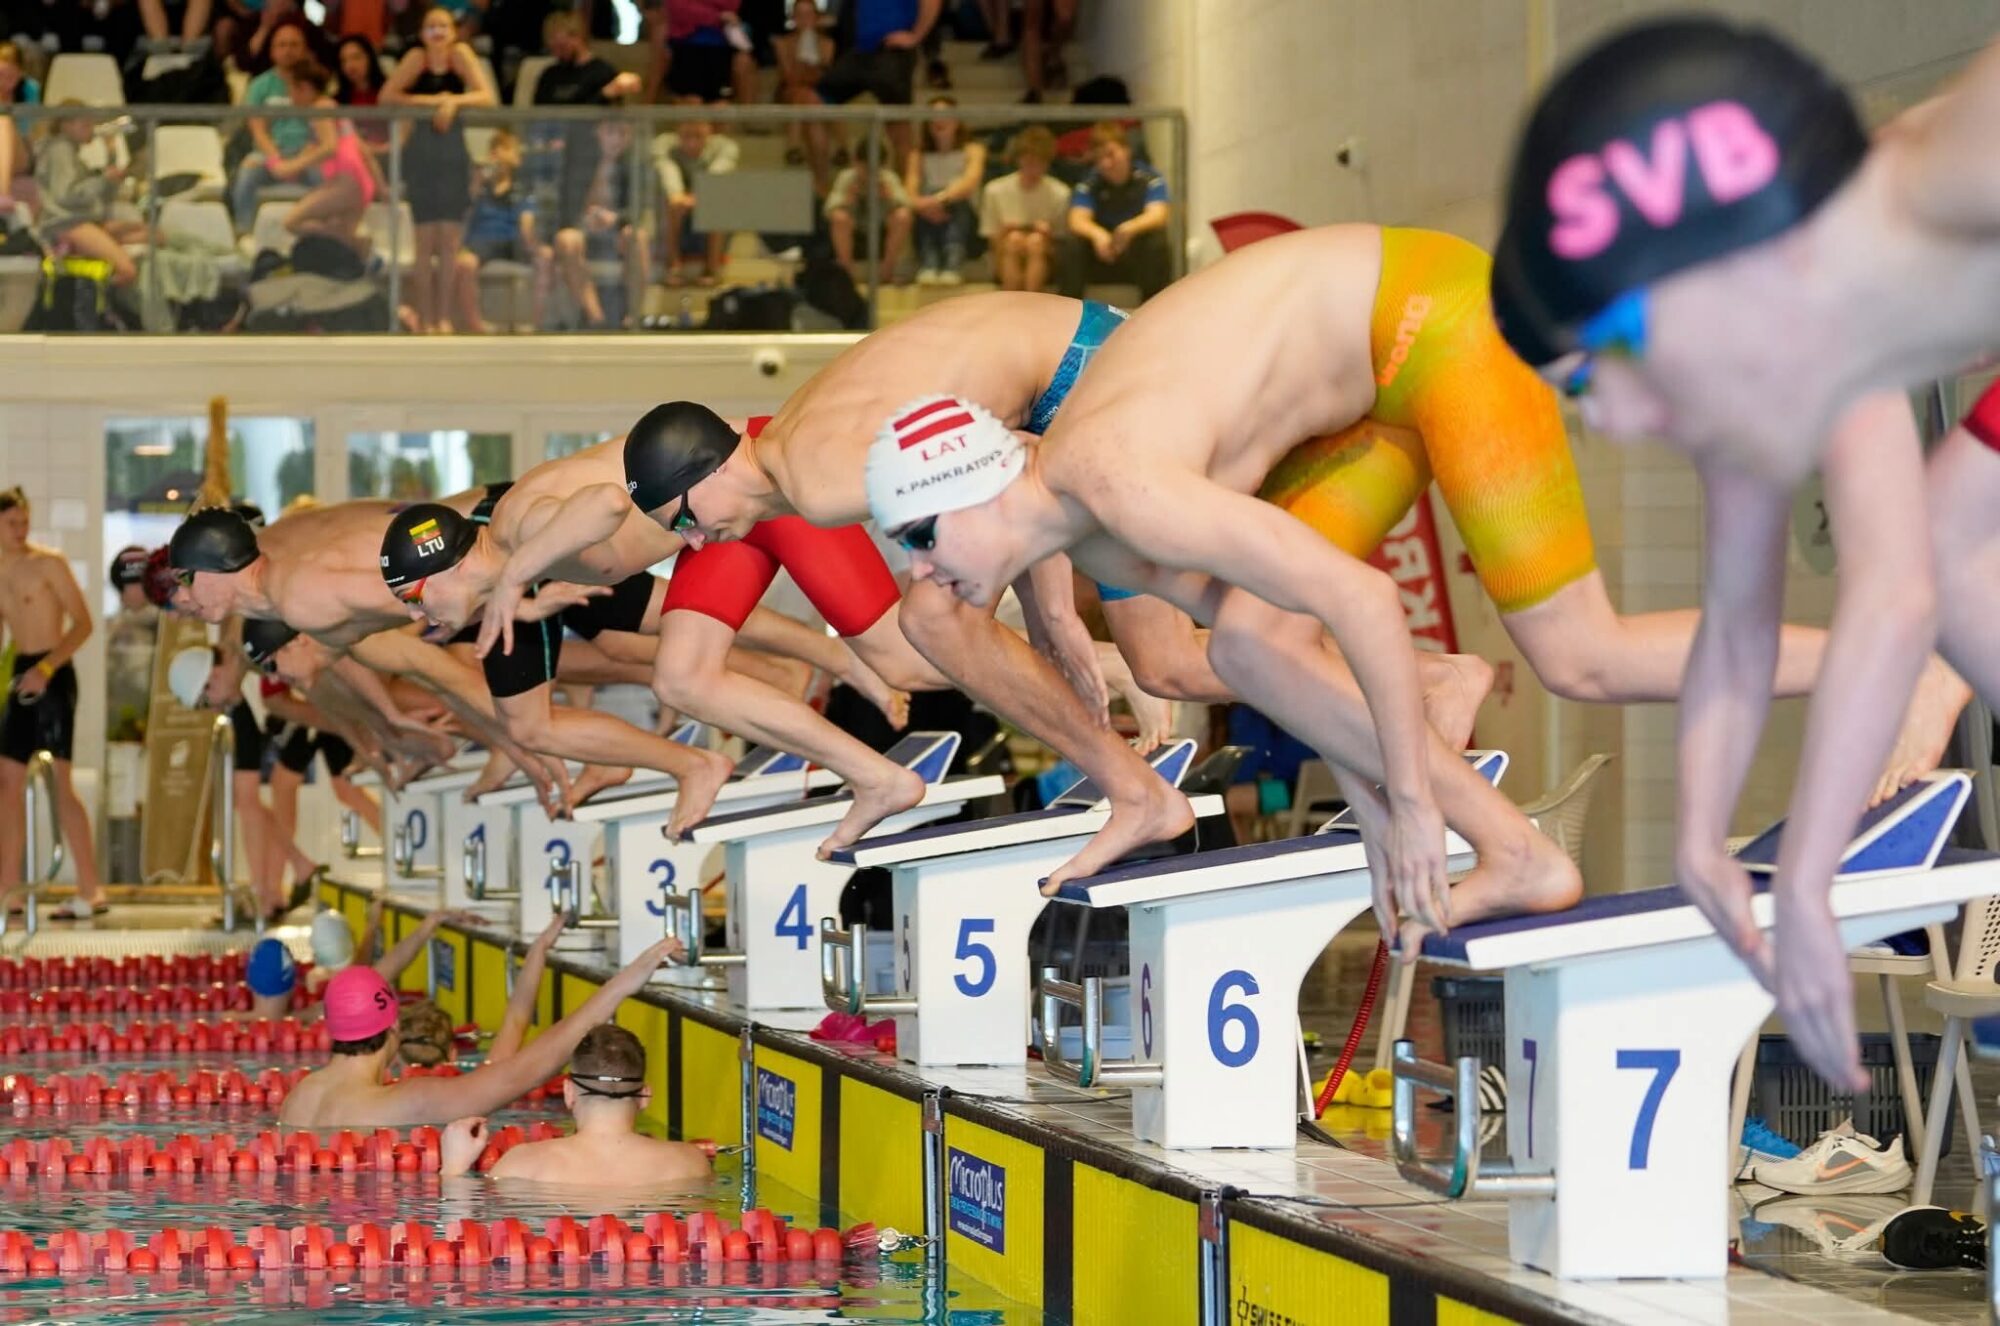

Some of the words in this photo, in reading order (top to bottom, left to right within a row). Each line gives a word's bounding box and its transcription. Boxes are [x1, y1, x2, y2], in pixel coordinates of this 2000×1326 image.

[1547, 101, 1779, 260] SVB
[921, 434, 967, 461] LAT
[417, 536, 445, 558] LTU
[406, 809, 427, 849] 0
[646, 859, 676, 916] 3
[775, 884, 814, 950] 4
[954, 918, 997, 998] 5
[1141, 962, 1153, 1060] 6
[1207, 969, 1260, 1068] 6
[1616, 1050, 1681, 1169] 7
